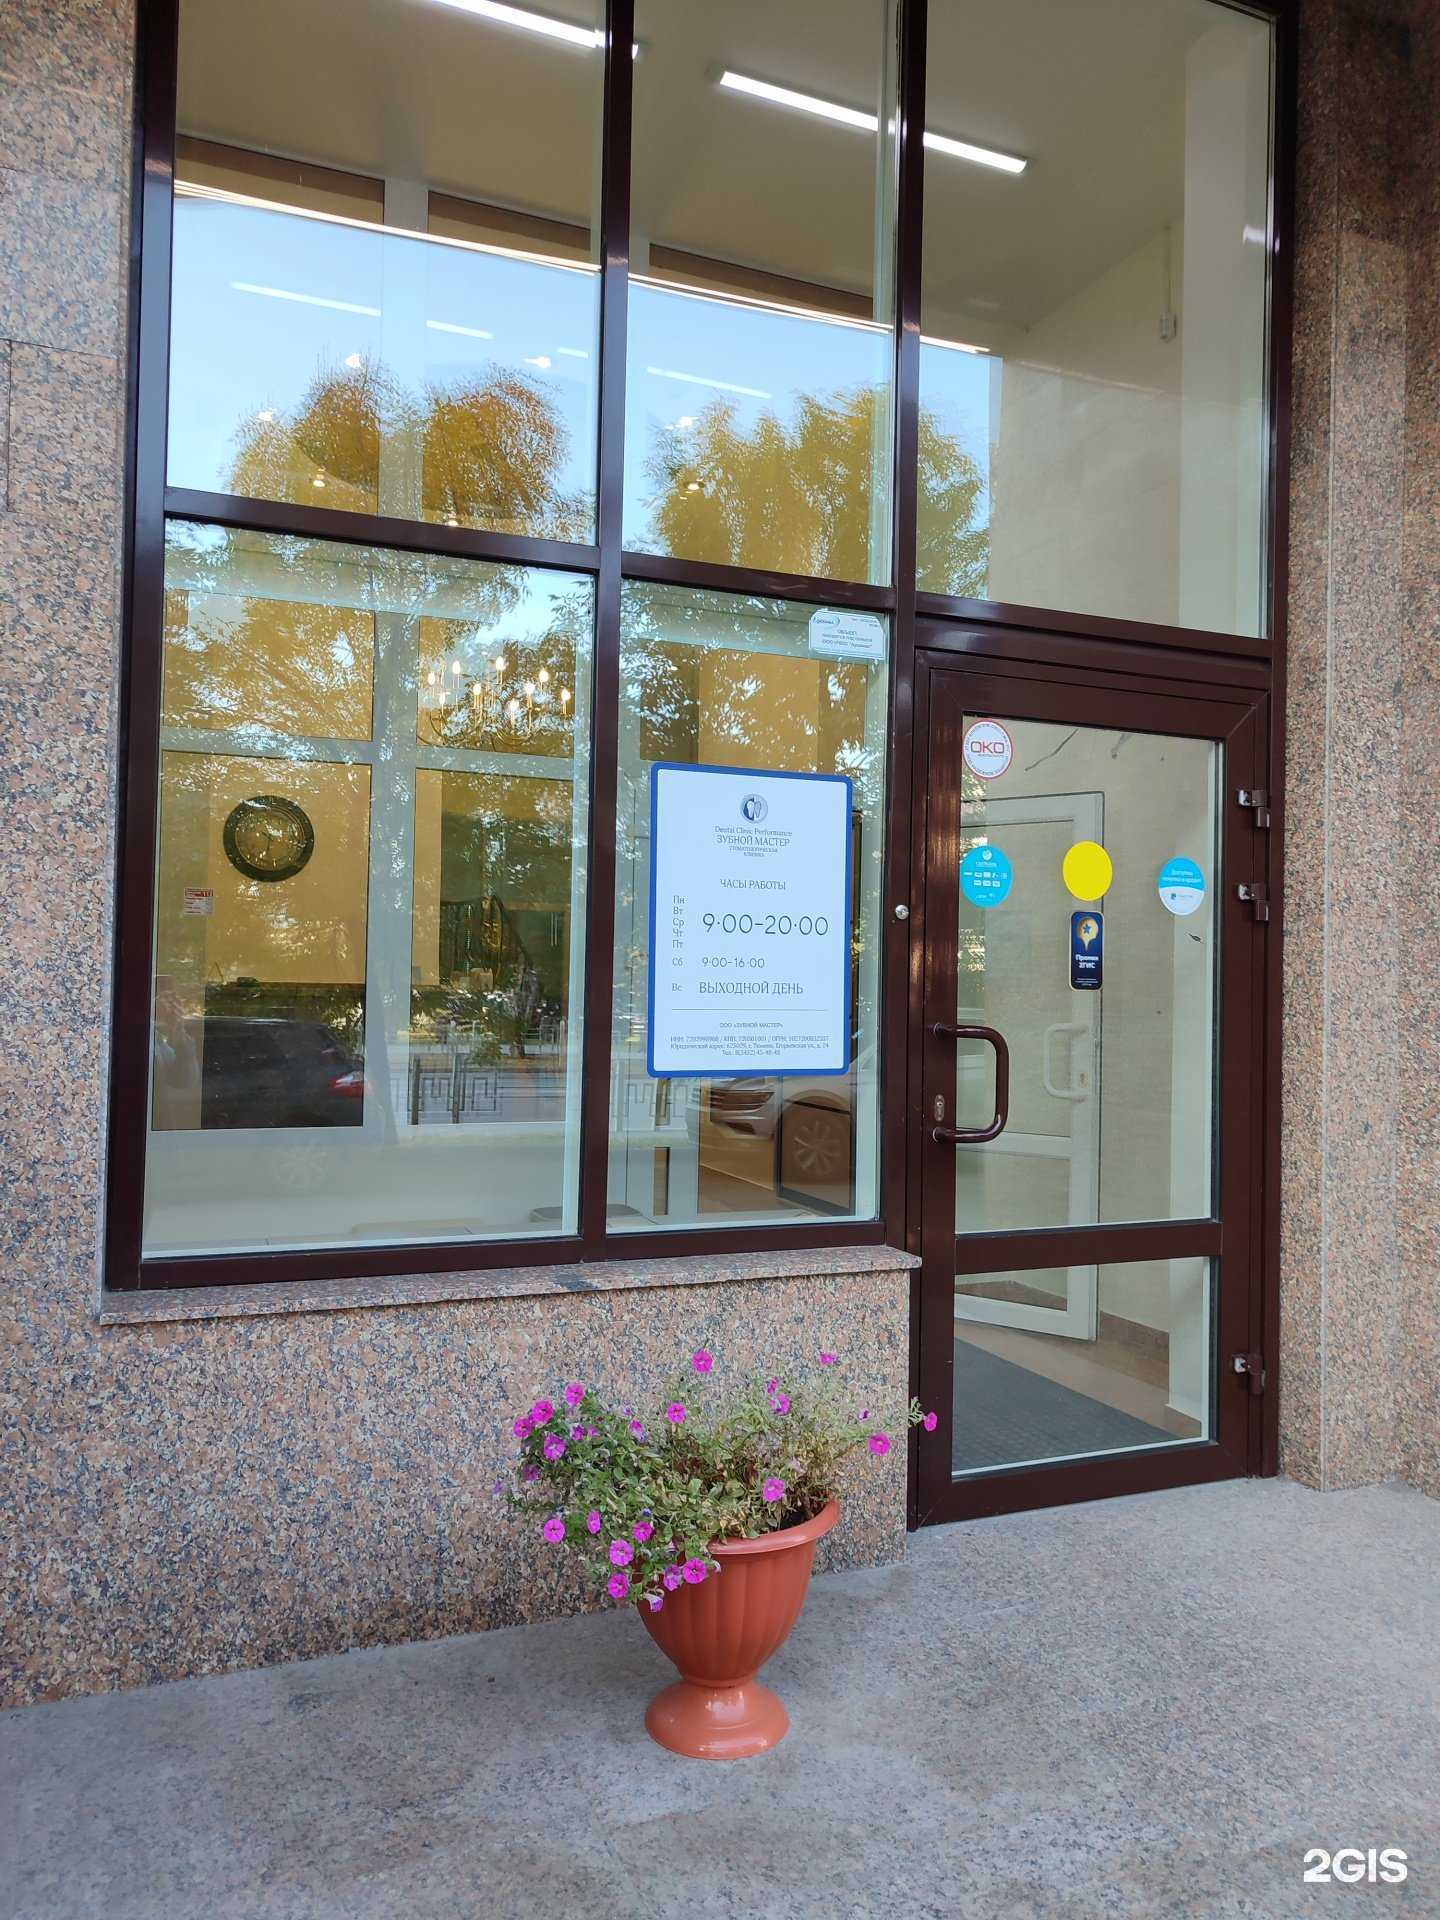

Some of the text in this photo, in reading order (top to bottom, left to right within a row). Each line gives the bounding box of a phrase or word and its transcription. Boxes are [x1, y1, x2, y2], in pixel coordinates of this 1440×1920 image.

[716, 834, 790, 847] ЗУБНОЙ МАСТЕР
[720, 878, 787, 890] ЧАСЫ РАБОТЫ
[673, 895, 686, 904] Пн
[673, 907, 684, 915] Вт
[672, 918, 685, 929] Ср
[672, 929, 684, 938] Чт
[672, 940, 684, 949] Пт
[672, 957, 683, 966] Сб
[672, 981, 803, 995] Вс ВЫХОДНОЙ ДЕНЬ
